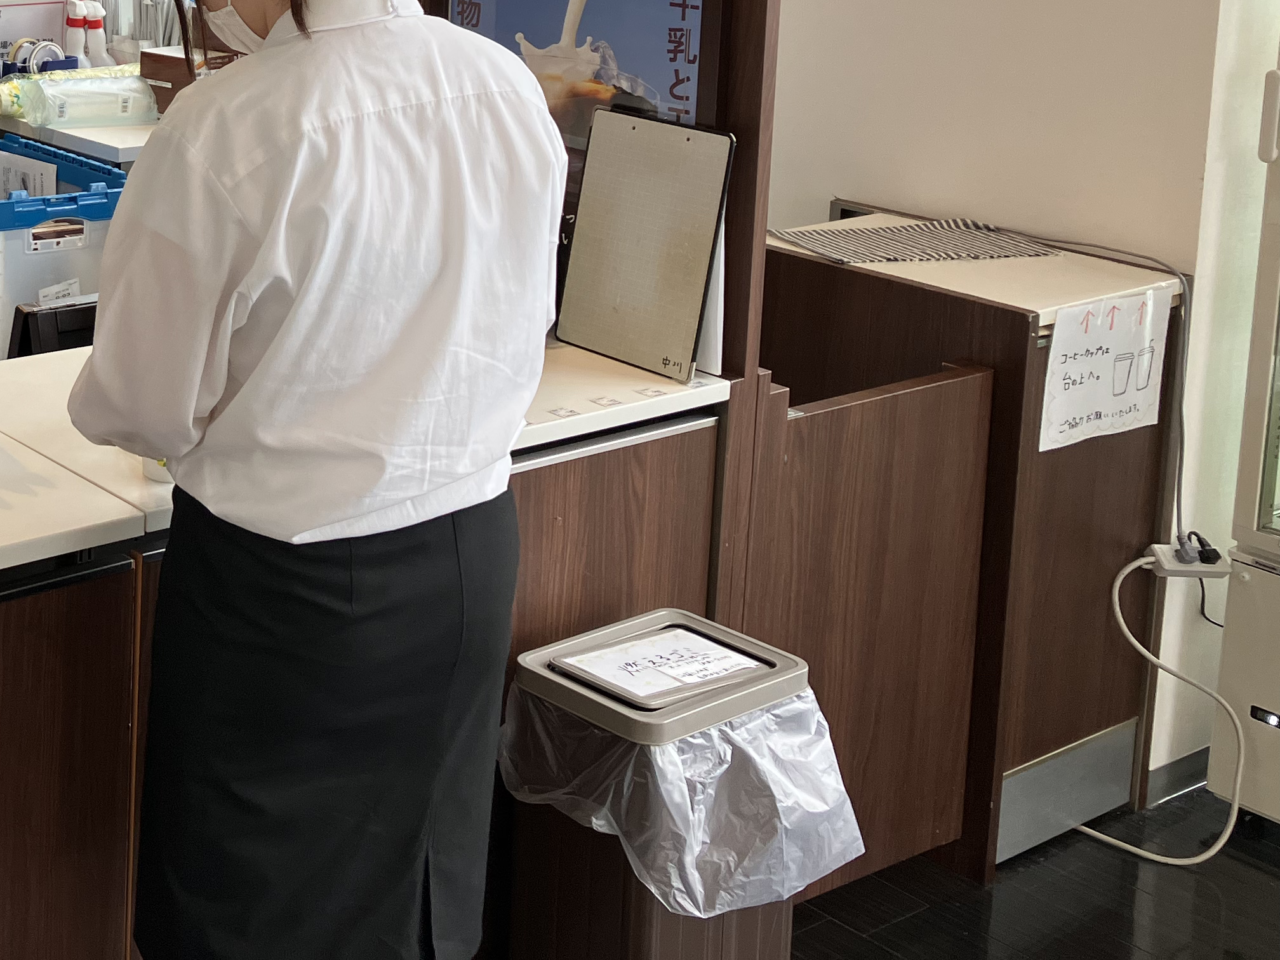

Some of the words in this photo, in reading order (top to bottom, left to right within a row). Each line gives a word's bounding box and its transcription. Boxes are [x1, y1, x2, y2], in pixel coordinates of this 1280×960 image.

[1061, 345, 1110, 365] コーヒーカップは
[662, 356, 683, 373] 中川
